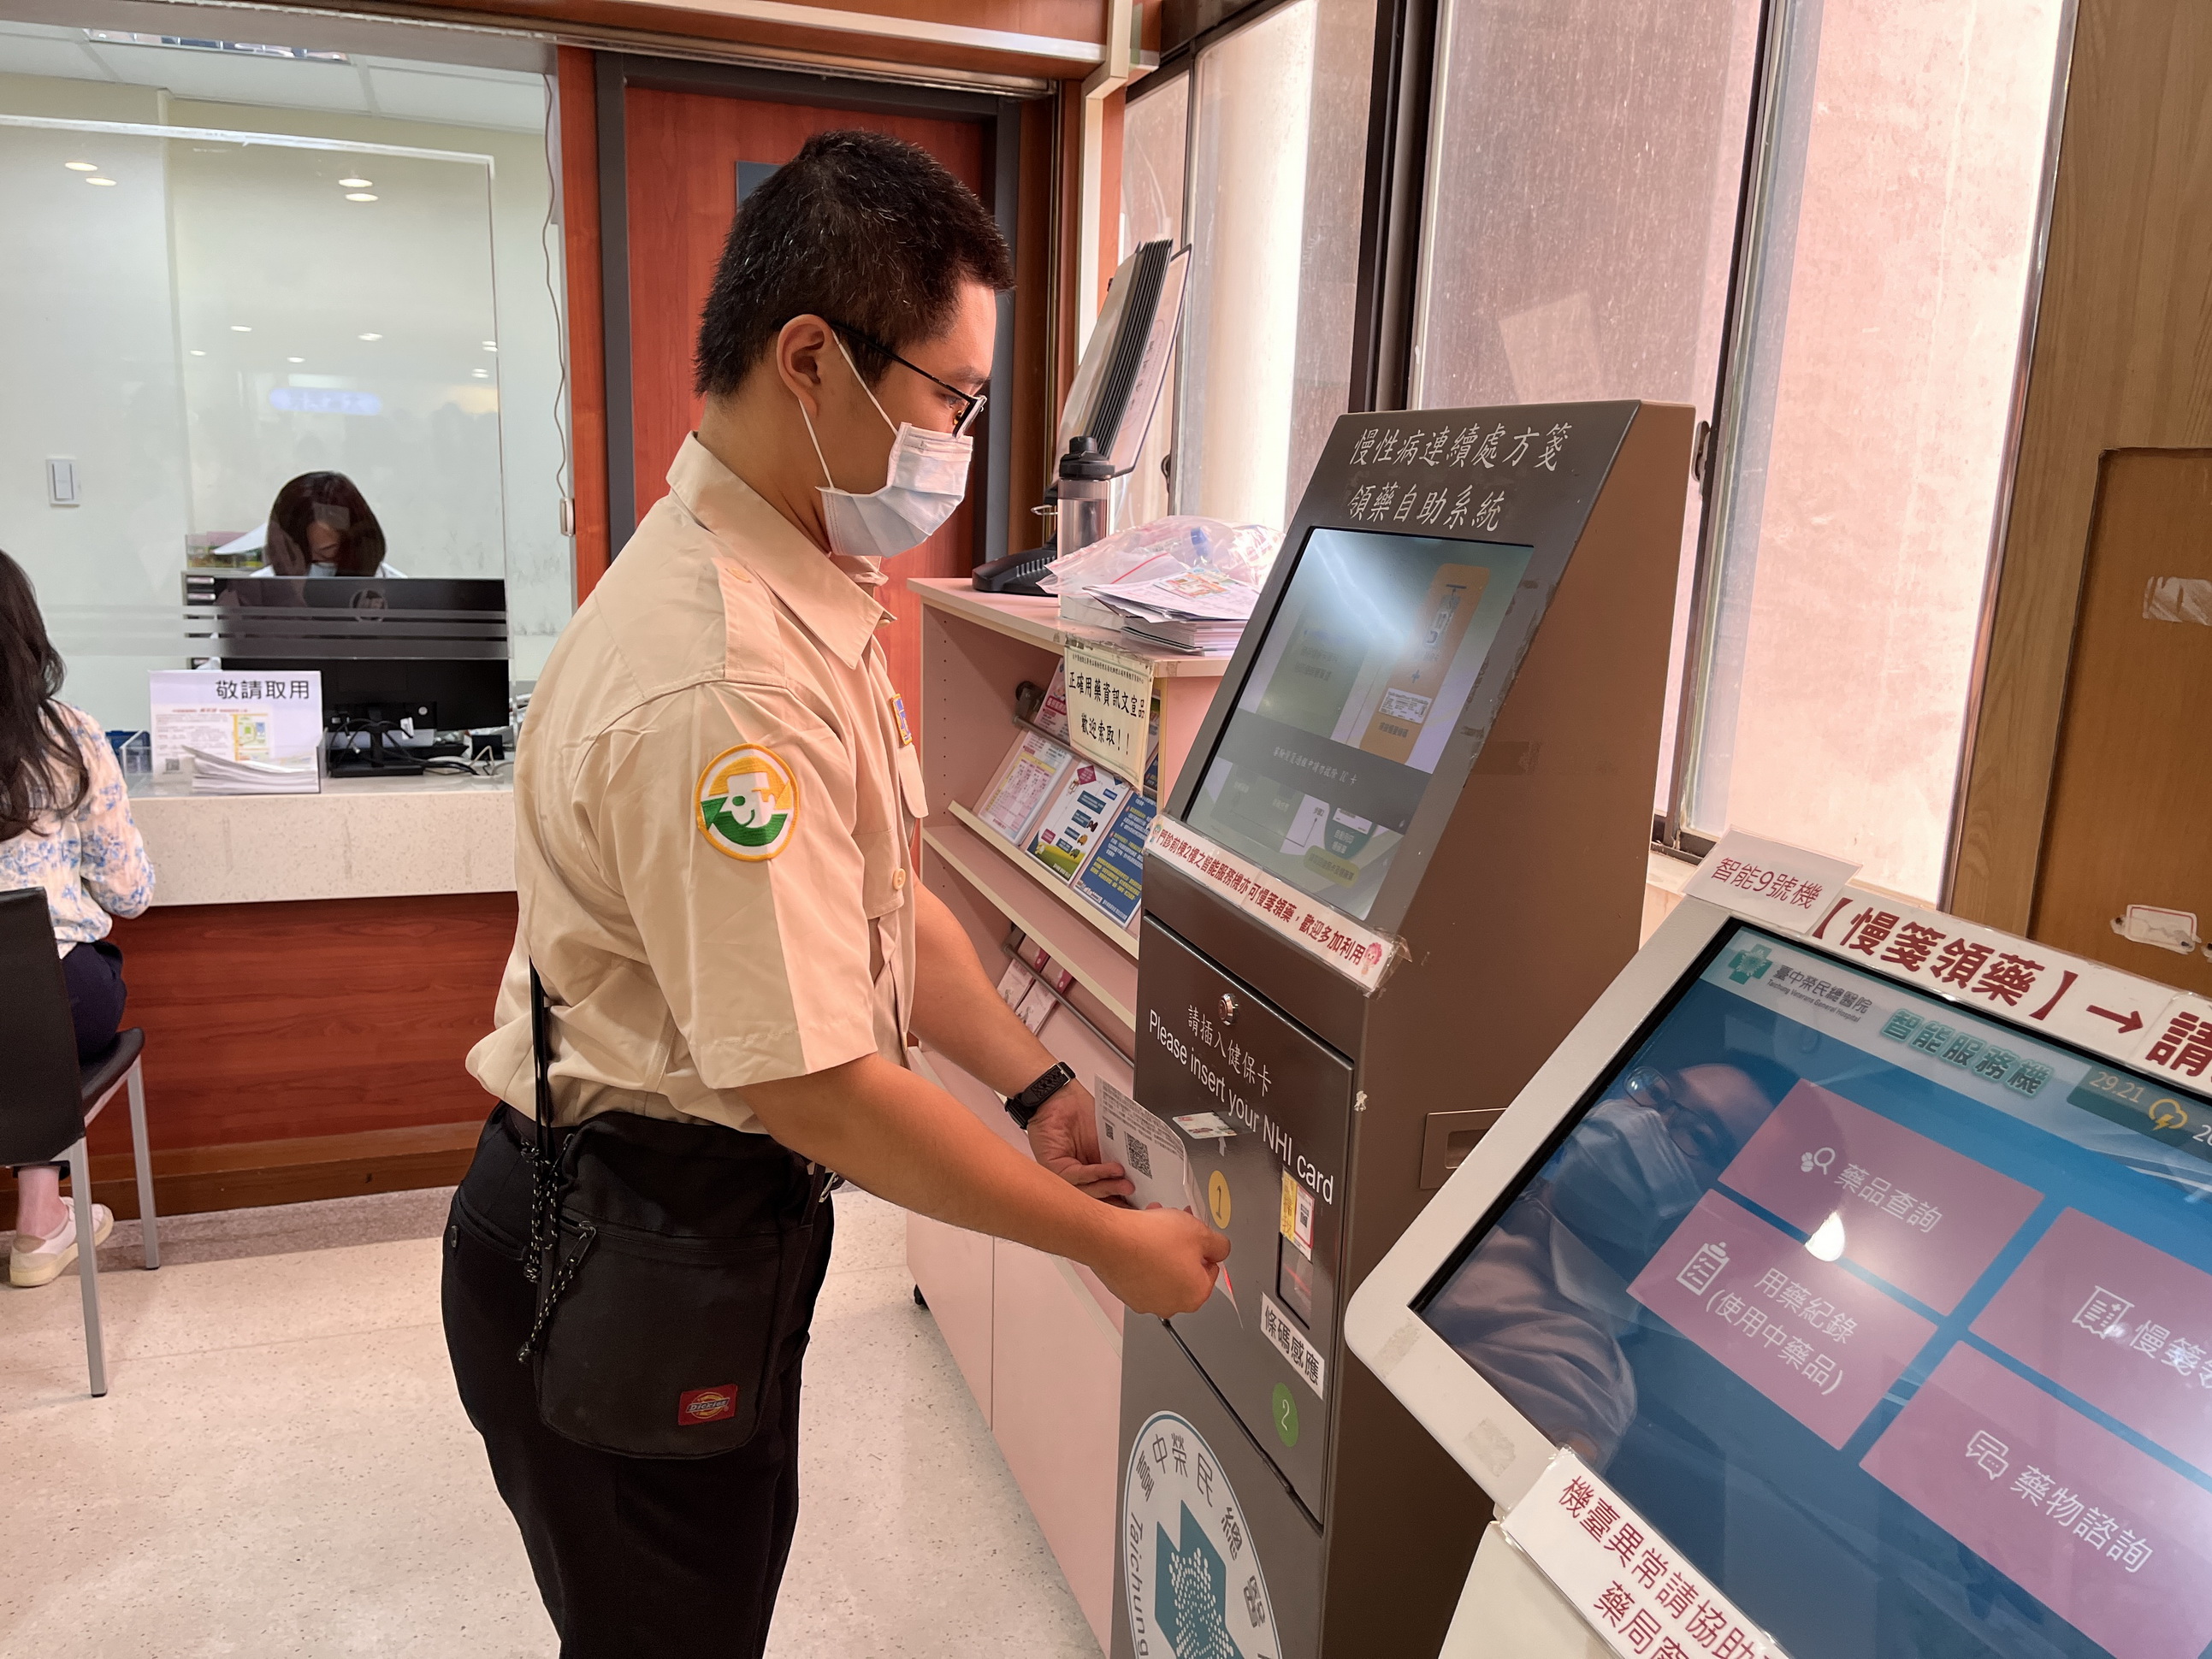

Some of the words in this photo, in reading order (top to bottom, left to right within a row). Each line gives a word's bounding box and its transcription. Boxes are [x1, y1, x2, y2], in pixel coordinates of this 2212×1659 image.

[1350, 422, 1572, 471] 慢性病連續處方箋
[1347, 481, 1505, 532] 領藥自助系統
[216, 680, 310, 700] 敬請取用
[1068, 671, 1145, 718] 正確用藥資訊文宣品
[1712, 857, 1823, 909] 智能9號機
[1773, 965, 1872, 1014] 臺中榮民總醫院
[1813, 897, 2079, 1020] 【慢箋領藥】
[1767, 979, 1791, 995] Taichung
[1791, 989, 1814, 1004] Veterans
[1814, 999, 1836, 1013] General
[1836, 1007, 1861, 1023] Hospital
[1188, 1004, 1272, 1097] 請插入健保卡
[1882, 1010, 2052, 1095] 智能服務機
[1149, 1008, 1187, 1066] Please
[1190, 1047, 1225, 1102] insert
[1228, 1089, 1260, 1133] your
[1263, 1114, 1292, 1166] NHI
[1297, 1154, 1334, 1204] card
[2089, 1072, 2144, 1103] 29.21
[1215, 1185, 1222, 1220] 1
[1834, 1163, 1943, 1232] 藥品查詢
[1754, 1267, 1858, 1344] 用藥紀錄
[1264, 1305, 1319, 1385] 條碼感應
[1706, 1290, 1843, 1395] (使用中藥品)
[1281, 1399, 1290, 1432] 2
[1136, 1432, 1270, 1659] 臺中榮民總醫
[2010, 1465, 2153, 1573] 藥物諮詢
[1130, 1512, 1150, 1656] Taichung
[1558, 1475, 1771, 1659] 機臺異常請協助
